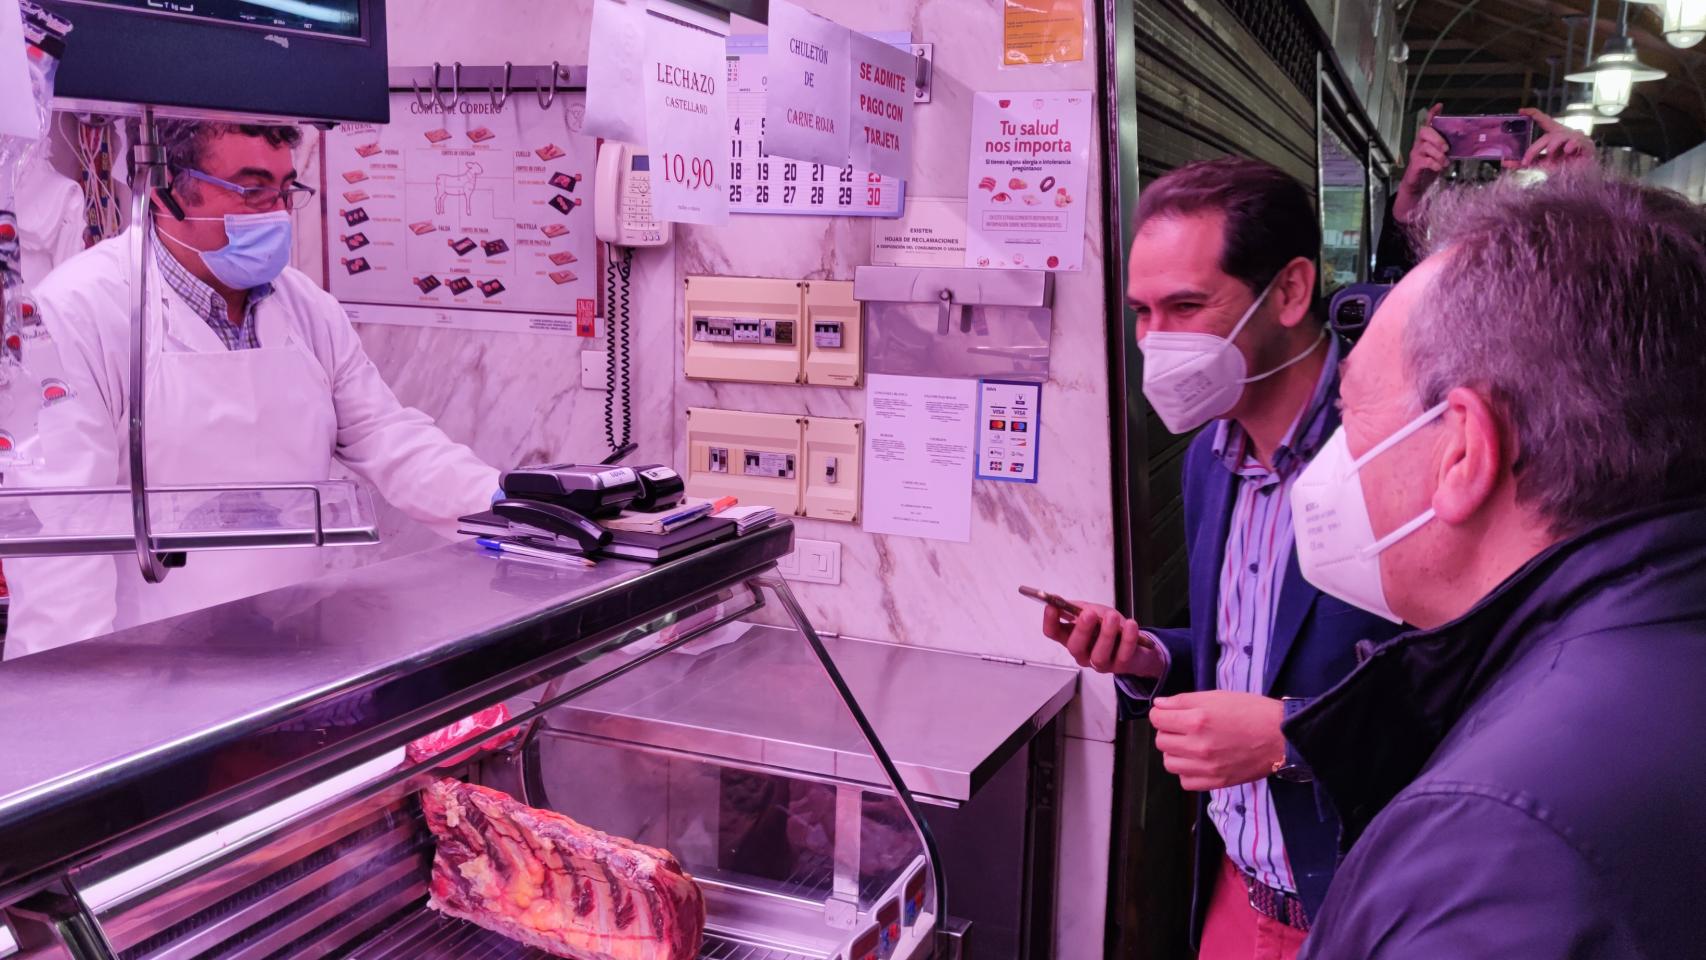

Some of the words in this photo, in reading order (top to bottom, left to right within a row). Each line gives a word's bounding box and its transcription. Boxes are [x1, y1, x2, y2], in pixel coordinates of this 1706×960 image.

[790, 38, 828, 64] CHULETÓN
[657, 62, 715, 95] LECHAZO
[804, 72, 814, 88] DE
[860, 62, 872, 81] SE
[874, 68, 906, 93] ADMITE
[666, 96, 708, 115] CASTELLANO
[860, 94, 884, 116] PAGO
[886, 102, 903, 122] CON
[734, 117, 740, 135] 4
[787, 108, 814, 126] CARNE
[815, 116, 835, 134] ROJA
[1000, 120, 1016, 136] Tu
[1020, 119, 1059, 136] salud
[732, 140, 742, 157] 11
[864, 126, 900, 152] TARJETA
[986, 141, 1011, 153] nos
[1014, 138, 1072, 157] importa
[663, 152, 714, 190] 10,90
[731, 162, 742, 180] 18
[758, 163, 769, 180] 19
[784, 163, 797, 181] 20
[812, 164, 824, 182] 21
[840, 164, 853, 182] 22
[730, 185, 742, 202] 25
[756, 185, 769, 203] 26
[784, 186, 796, 203] 27
[811, 186, 824, 204] 28
[838, 187, 852, 205] 29
[867, 188, 881, 205] 30
